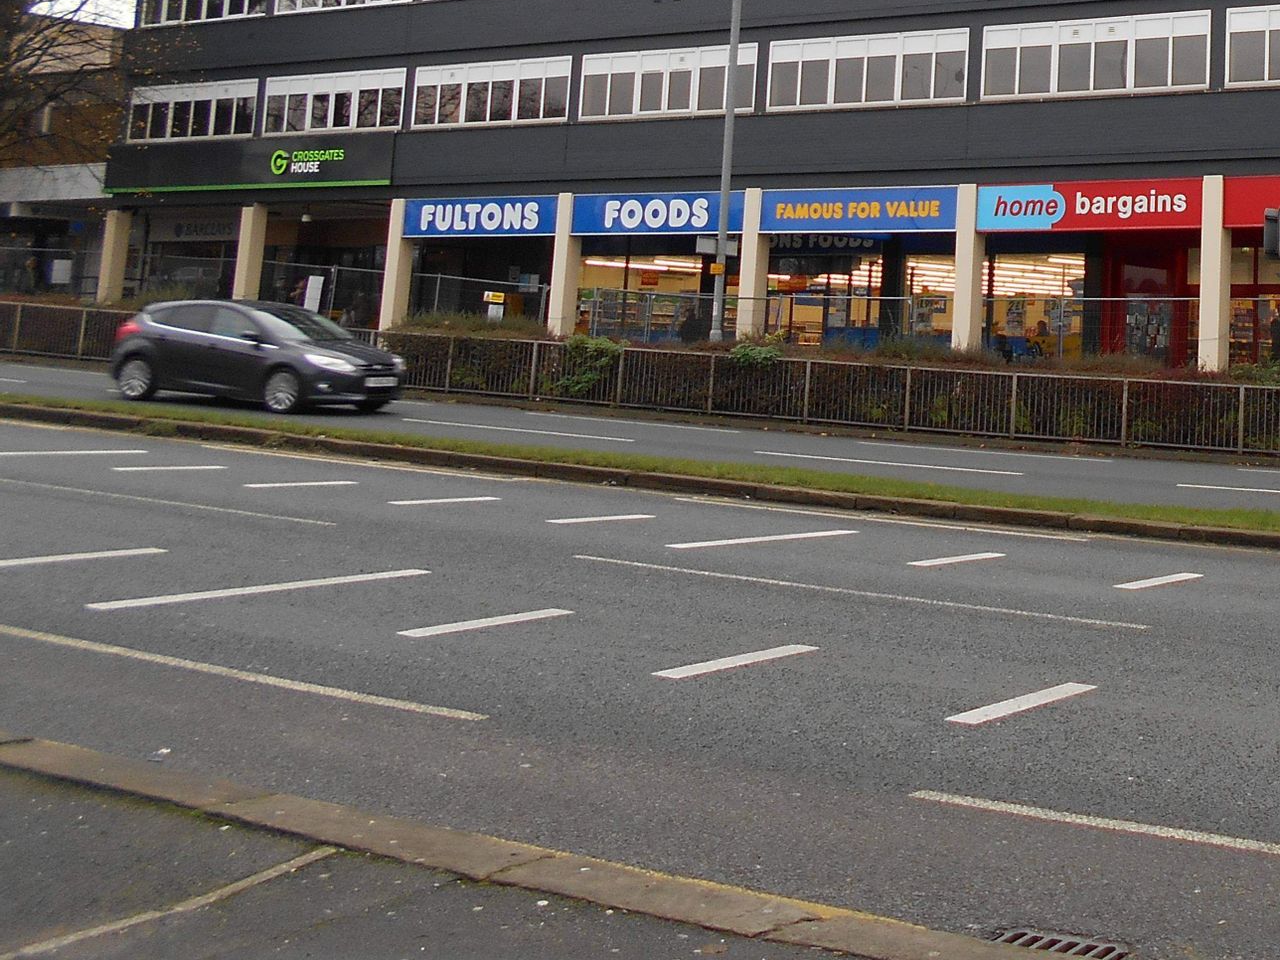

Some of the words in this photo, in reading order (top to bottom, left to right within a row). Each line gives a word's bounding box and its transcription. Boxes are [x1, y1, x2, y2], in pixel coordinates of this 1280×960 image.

[290, 161, 320, 173] HOUSE
[291, 149, 345, 162] CROSSGATES
[420, 201, 539, 231] FULTONS
[604, 197, 709, 229] FOODS
[776, 202, 844, 219] FAMOUS
[848, 201, 881, 218] FOR
[886, 200, 940, 217] VALUE
[993, 195, 1059, 217] home
[1075, 189, 1187, 219] bargains
